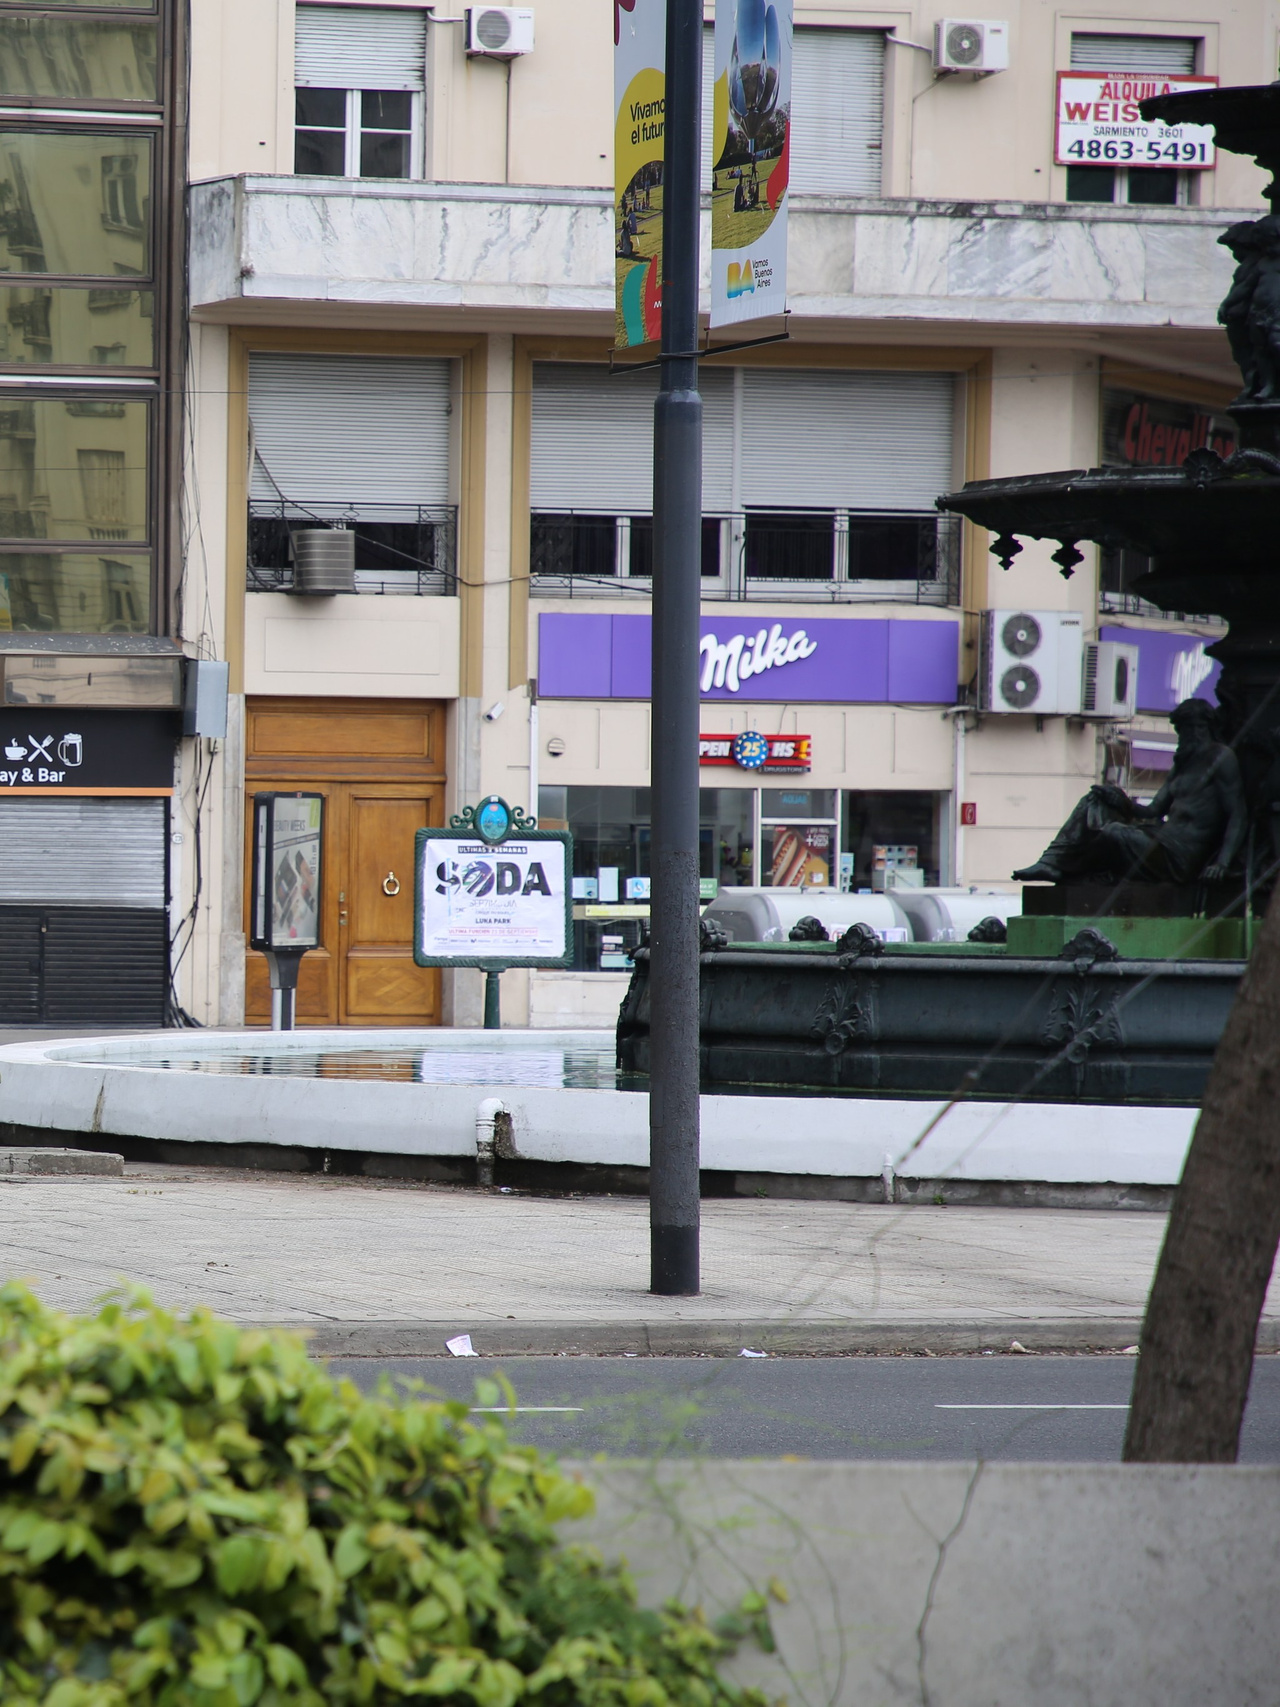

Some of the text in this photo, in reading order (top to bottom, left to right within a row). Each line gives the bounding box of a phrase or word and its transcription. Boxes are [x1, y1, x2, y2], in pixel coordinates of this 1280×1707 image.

[630, 98, 666, 122] Vivamo
[631, 121, 666, 145] el futur
[1093, 126, 1183, 139] SARMIENTO 3601
[1067, 139, 1206, 162] 4863-5491
[752, 259, 769, 269] Vamos
[754, 268, 773, 279] Buenos
[757, 279, 771, 289] Aires
[700, 623, 817, 693] Milka
[699, 741, 731, 757] PEN
[742, 742, 761, 757] 25
[21, 768, 34, 783] &
[38, 769, 65, 783] Bar
[435, 861, 552, 897] SODA
